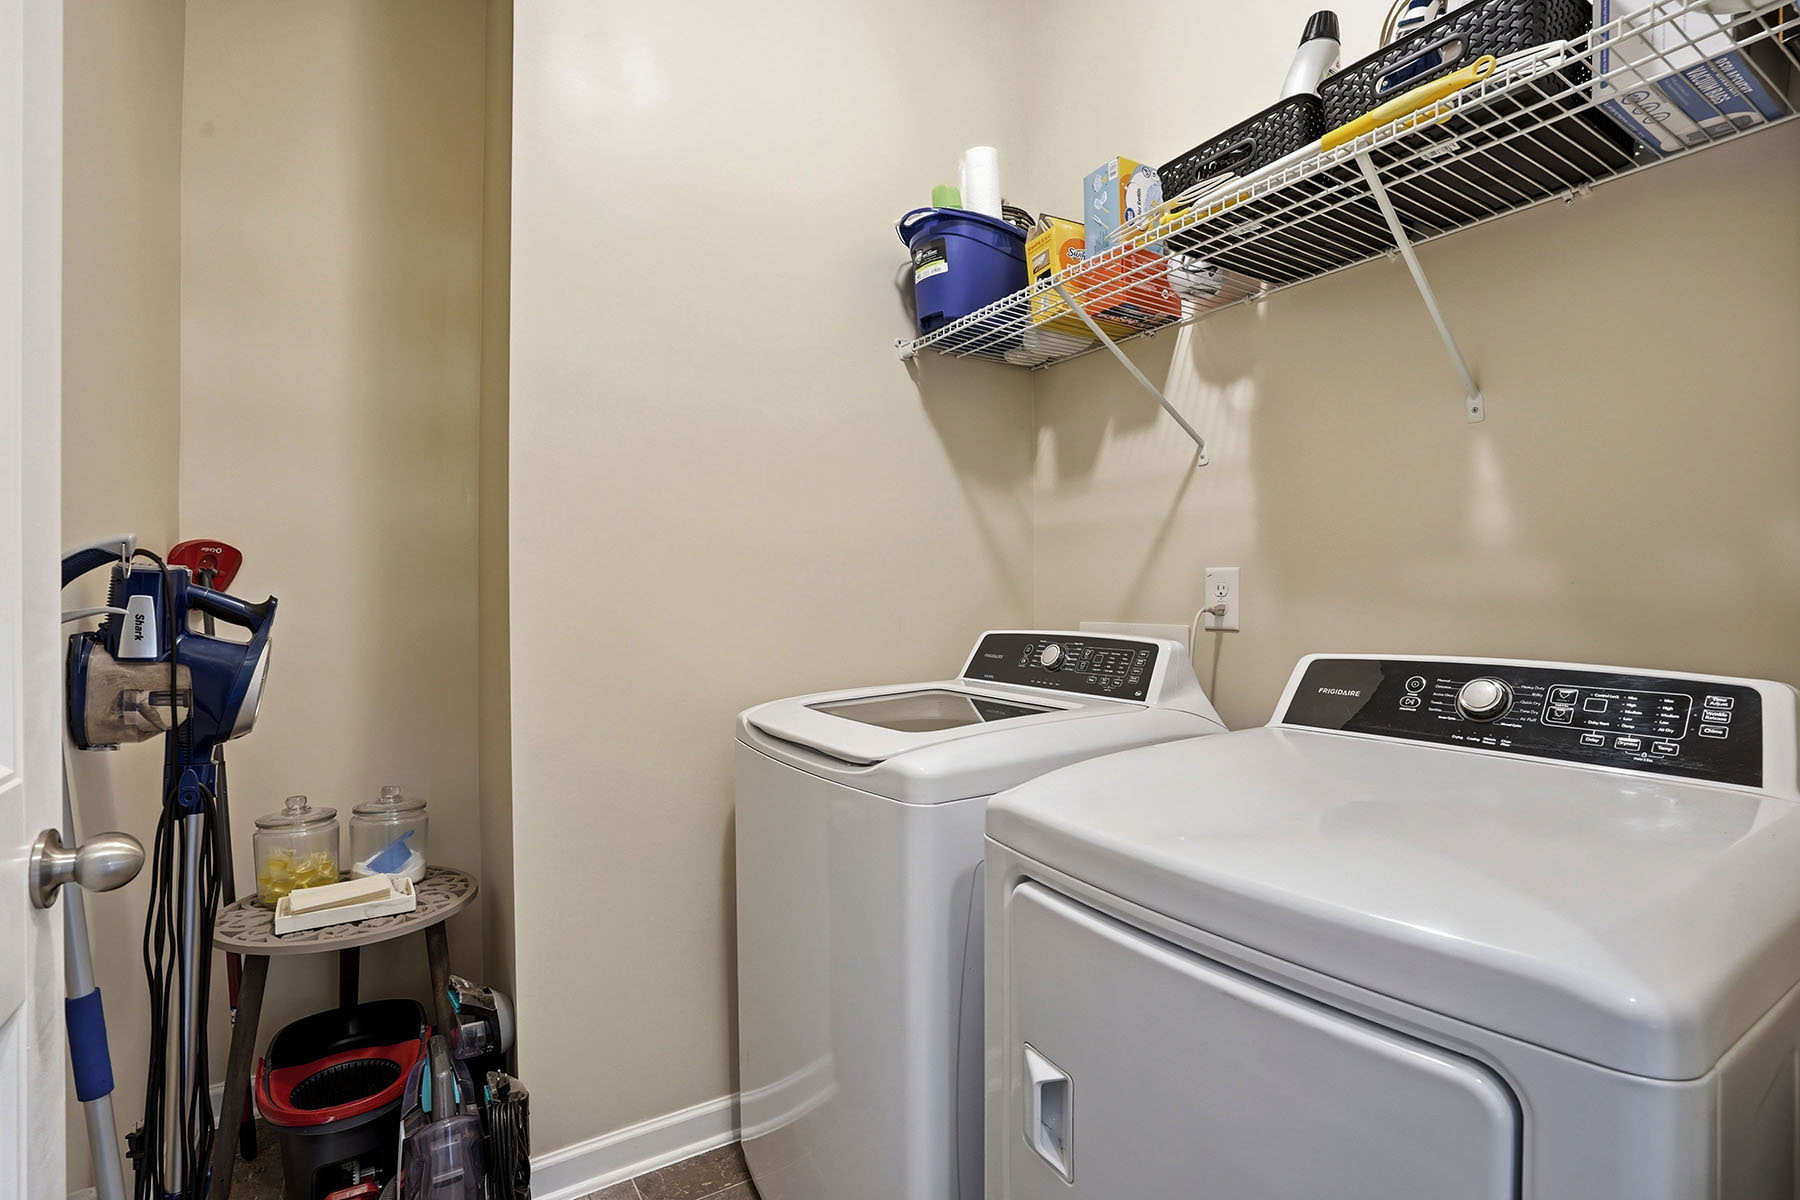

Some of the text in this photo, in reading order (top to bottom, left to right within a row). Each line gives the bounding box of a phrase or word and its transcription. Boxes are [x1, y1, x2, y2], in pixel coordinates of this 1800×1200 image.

[1686, 65, 1731, 105] VACUUM BAGS
[134, 613, 145, 641] Shark
[1318, 687, 1361, 697] FRIGIDAIRE
